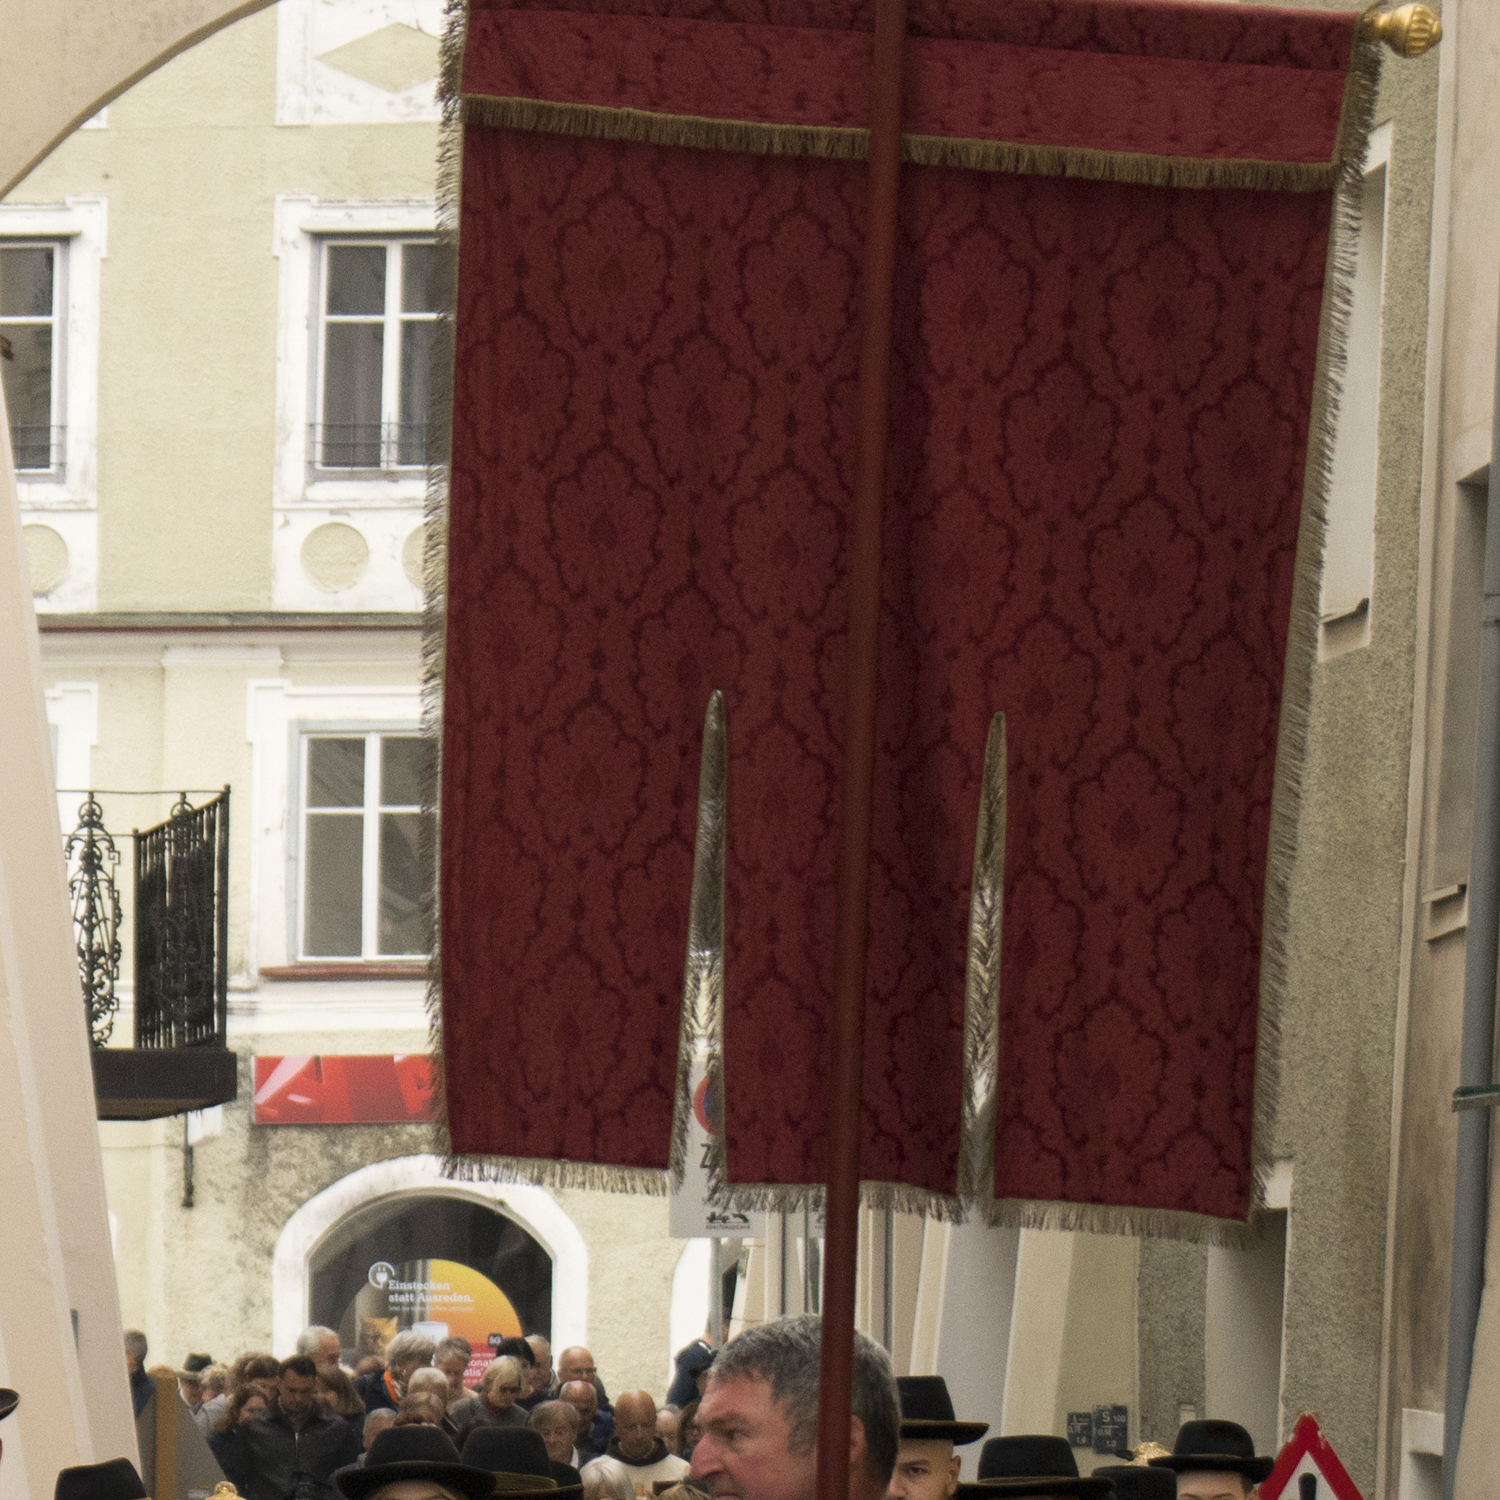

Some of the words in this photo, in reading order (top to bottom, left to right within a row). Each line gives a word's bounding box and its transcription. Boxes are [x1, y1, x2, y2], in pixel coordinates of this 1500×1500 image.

[388, 1280, 451, 1290] Einstecken
[388, 1293, 414, 1302] statt
[417, 1293, 474, 1303] Ausreden.
